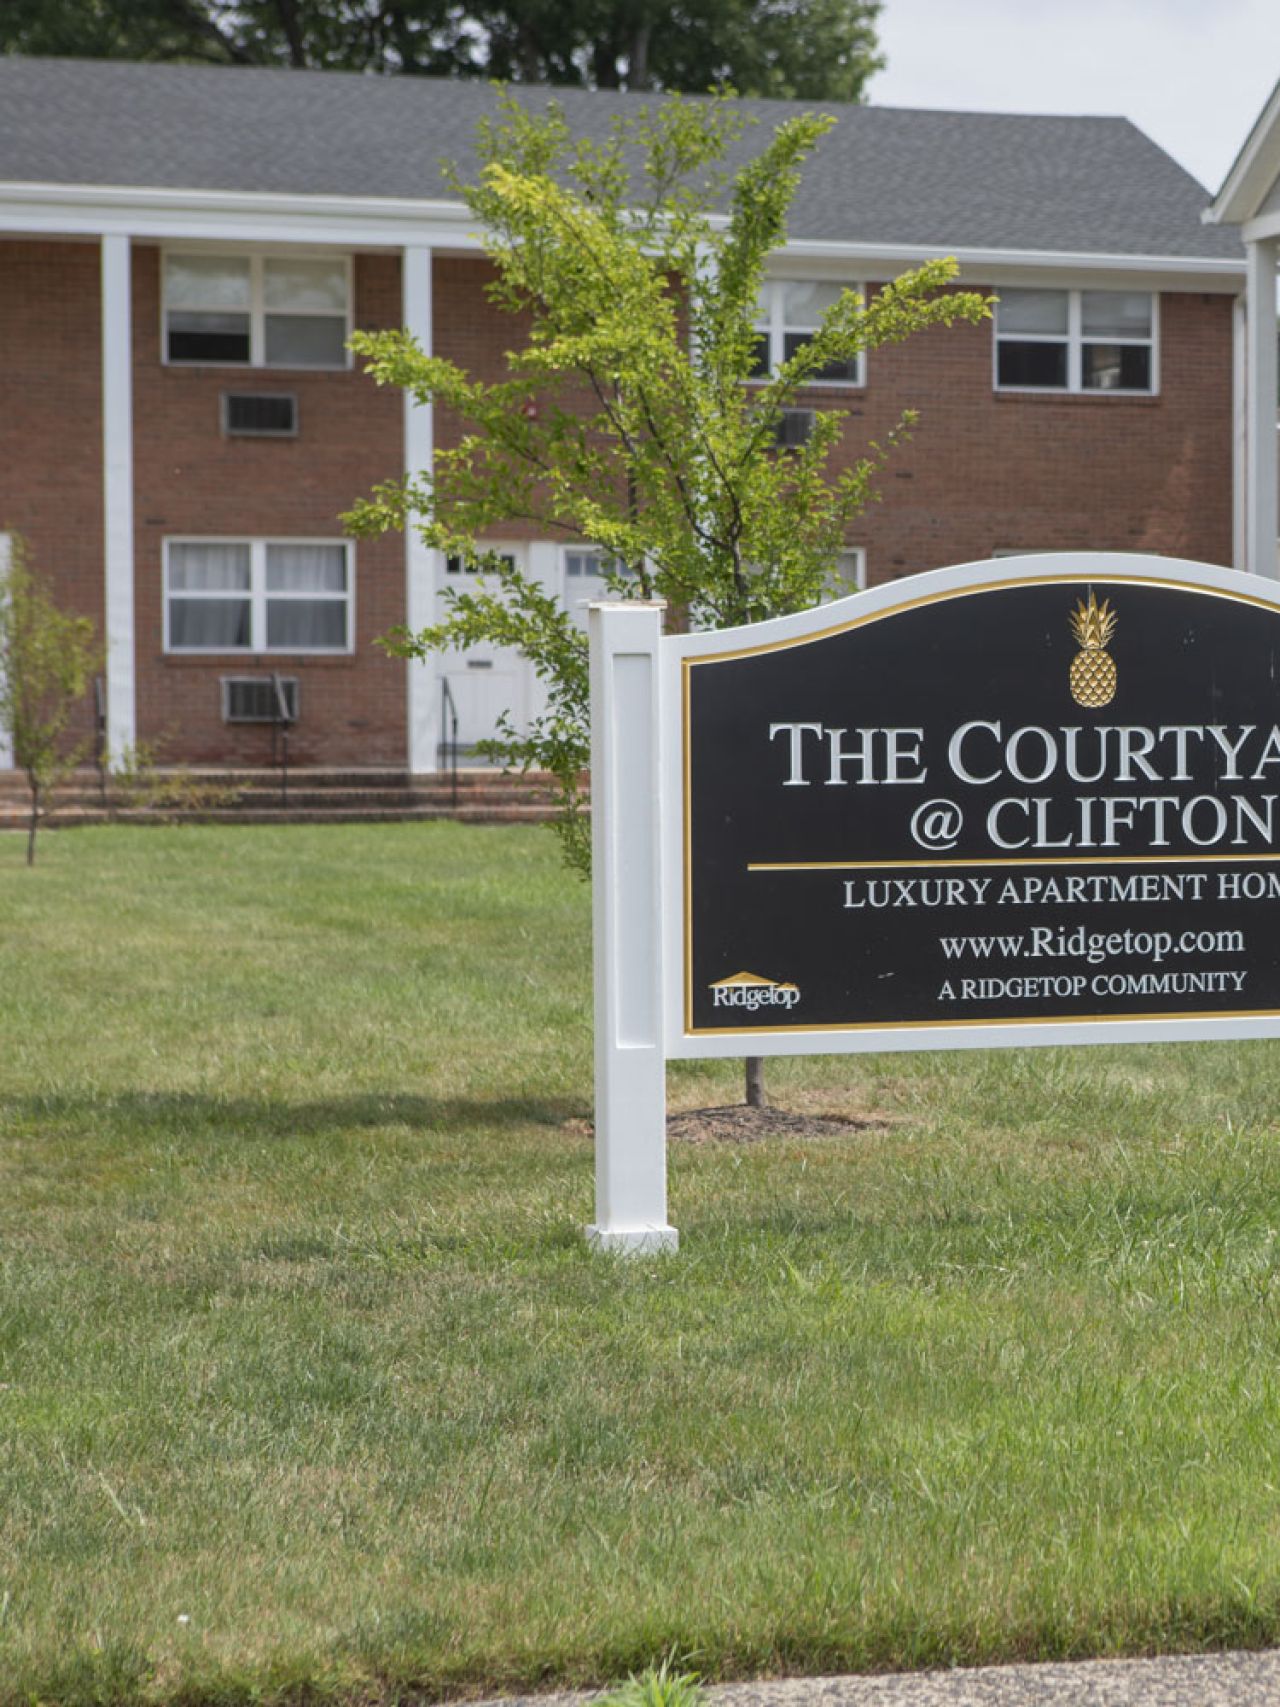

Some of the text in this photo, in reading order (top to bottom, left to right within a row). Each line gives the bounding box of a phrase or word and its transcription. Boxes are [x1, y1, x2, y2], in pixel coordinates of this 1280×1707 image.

[769, 722, 927, 785] THE
[911, 795, 1278, 850] @ CLIFTON
[843, 879, 991, 908] LUXURY
[997, 874, 1207, 903] APARTMENT
[940, 927, 1244, 963] www.Ridgetop.com
[712, 985, 801, 1011] Ridgetop
[938, 971, 1247, 1001] A RIDGETOP COMMUNITY
